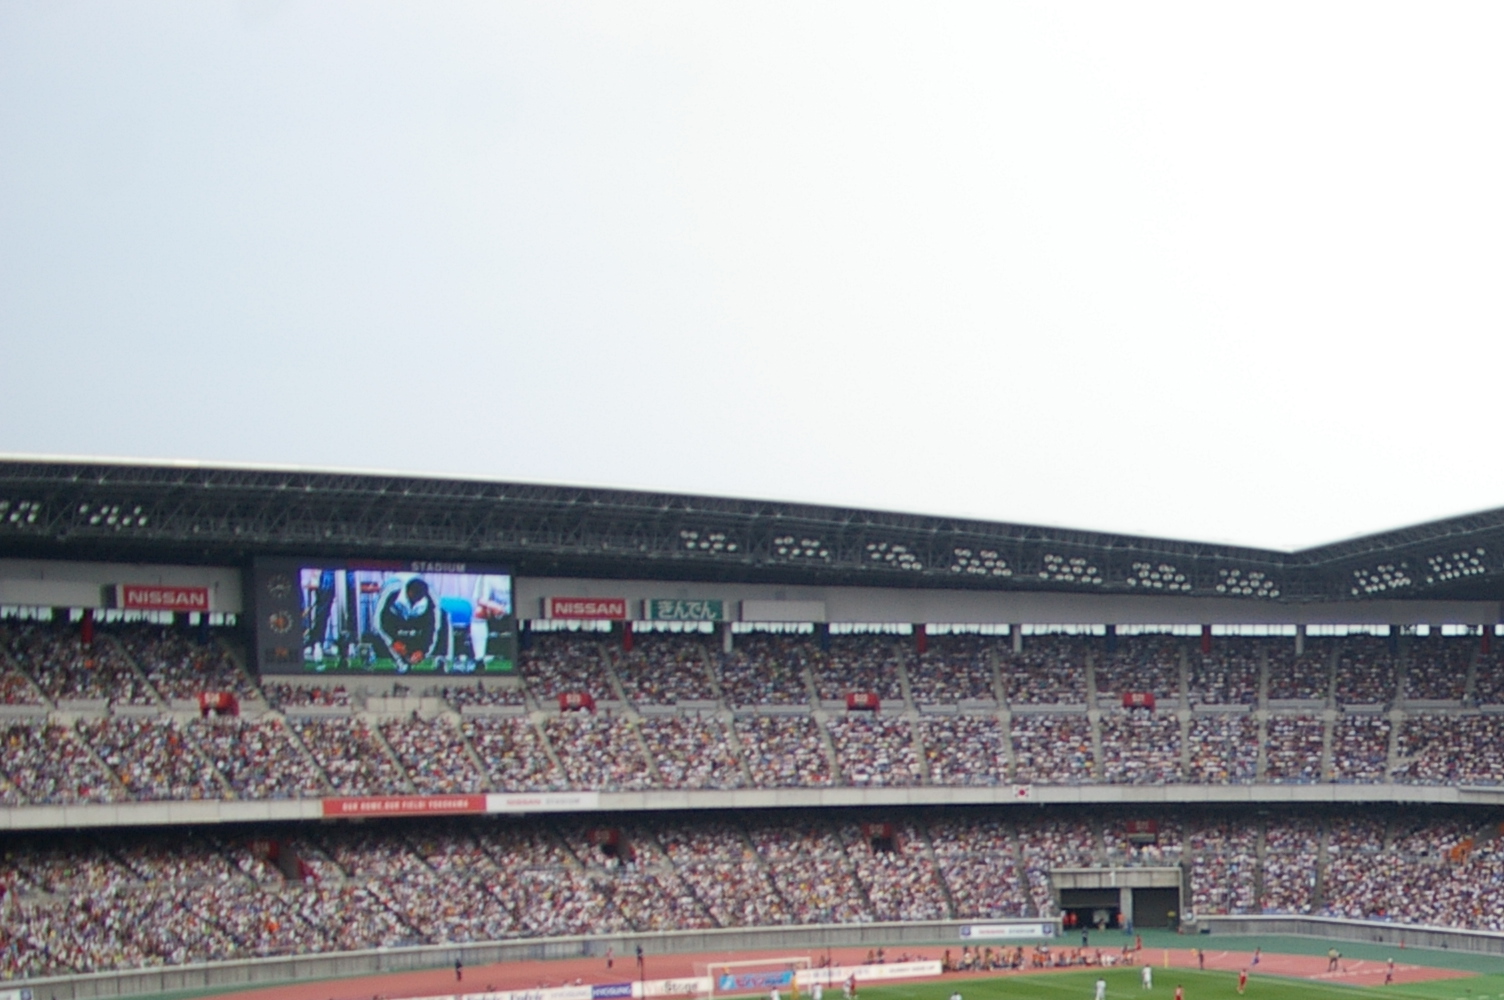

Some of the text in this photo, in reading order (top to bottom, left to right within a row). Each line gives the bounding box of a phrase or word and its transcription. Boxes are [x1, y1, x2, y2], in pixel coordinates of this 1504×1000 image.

[128, 590, 205, 606] NISSAN
[555, 602, 623, 615] NISSAN
[658, 601, 716, 618] きんでん
